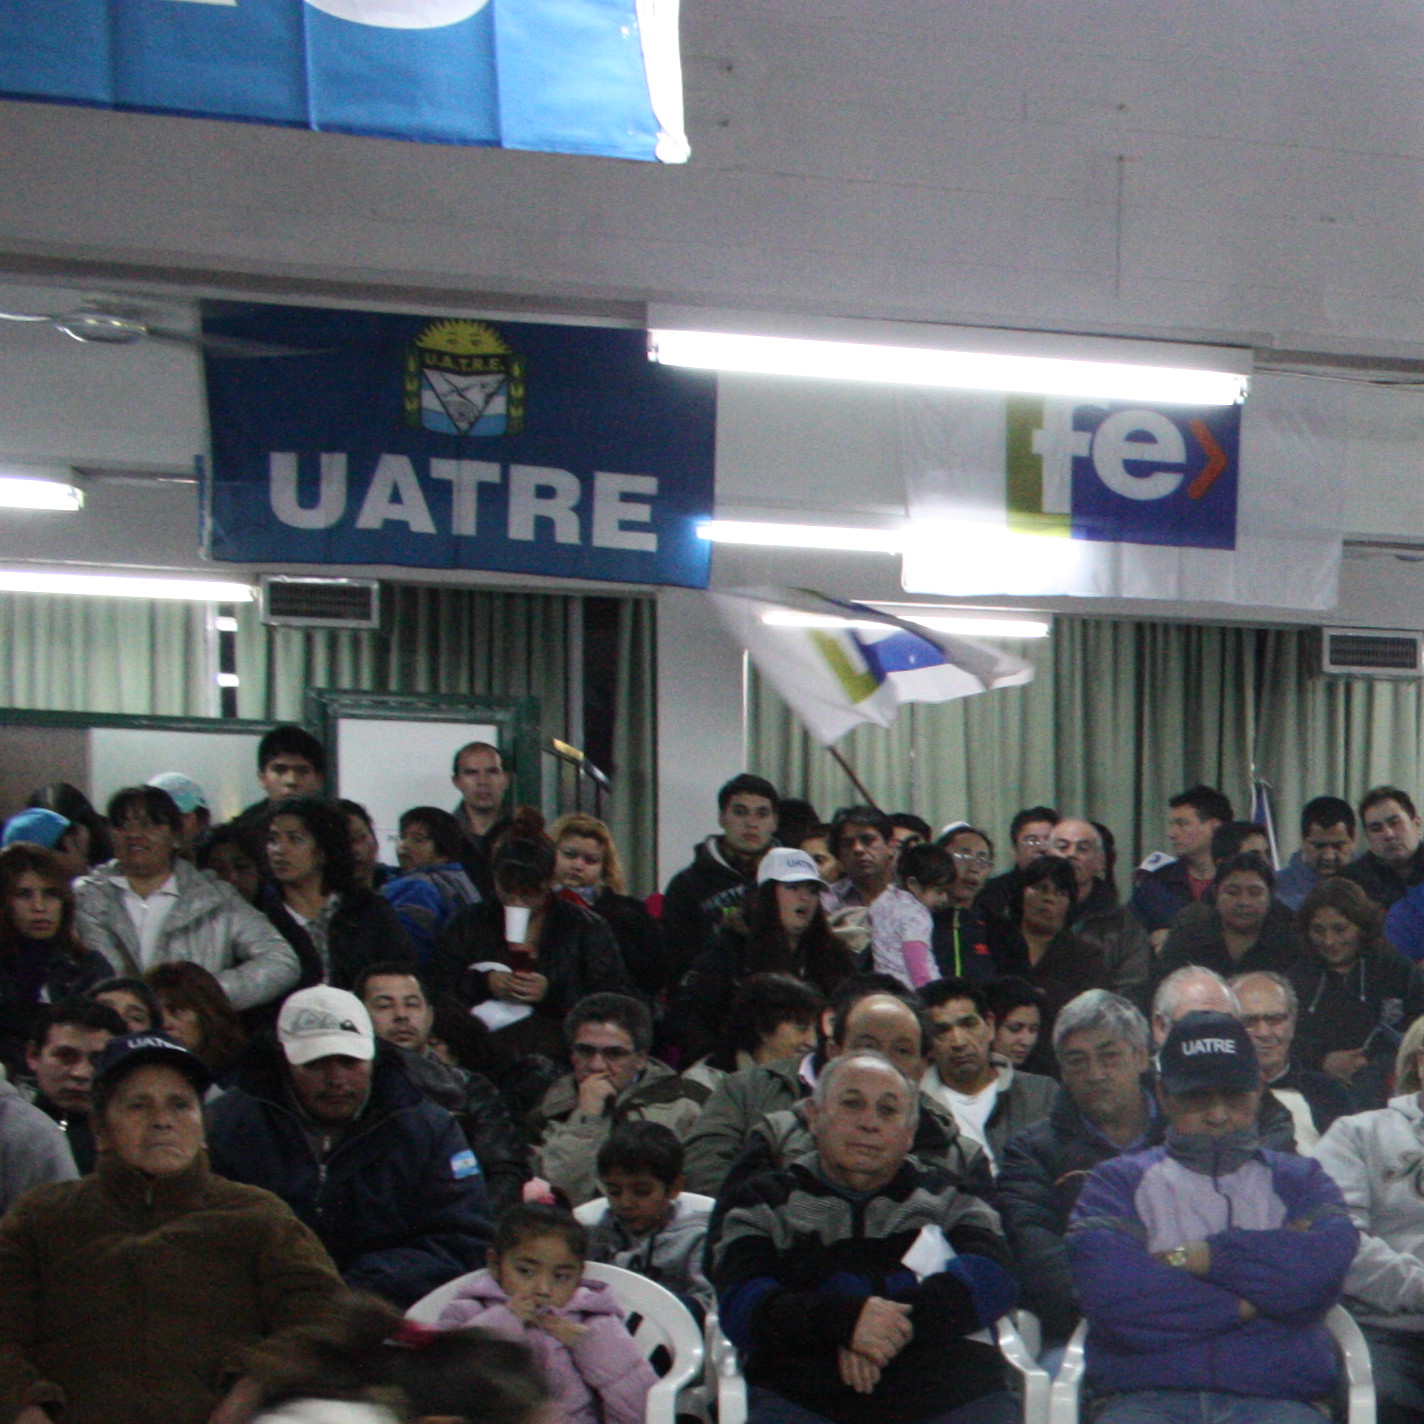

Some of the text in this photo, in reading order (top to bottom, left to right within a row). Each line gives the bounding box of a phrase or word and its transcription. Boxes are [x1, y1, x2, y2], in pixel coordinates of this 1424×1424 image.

[269, 452, 658, 553] UATRE
[127, 1036, 188, 1052] UAT
[1182, 1037, 1236, 1056] UATRE
